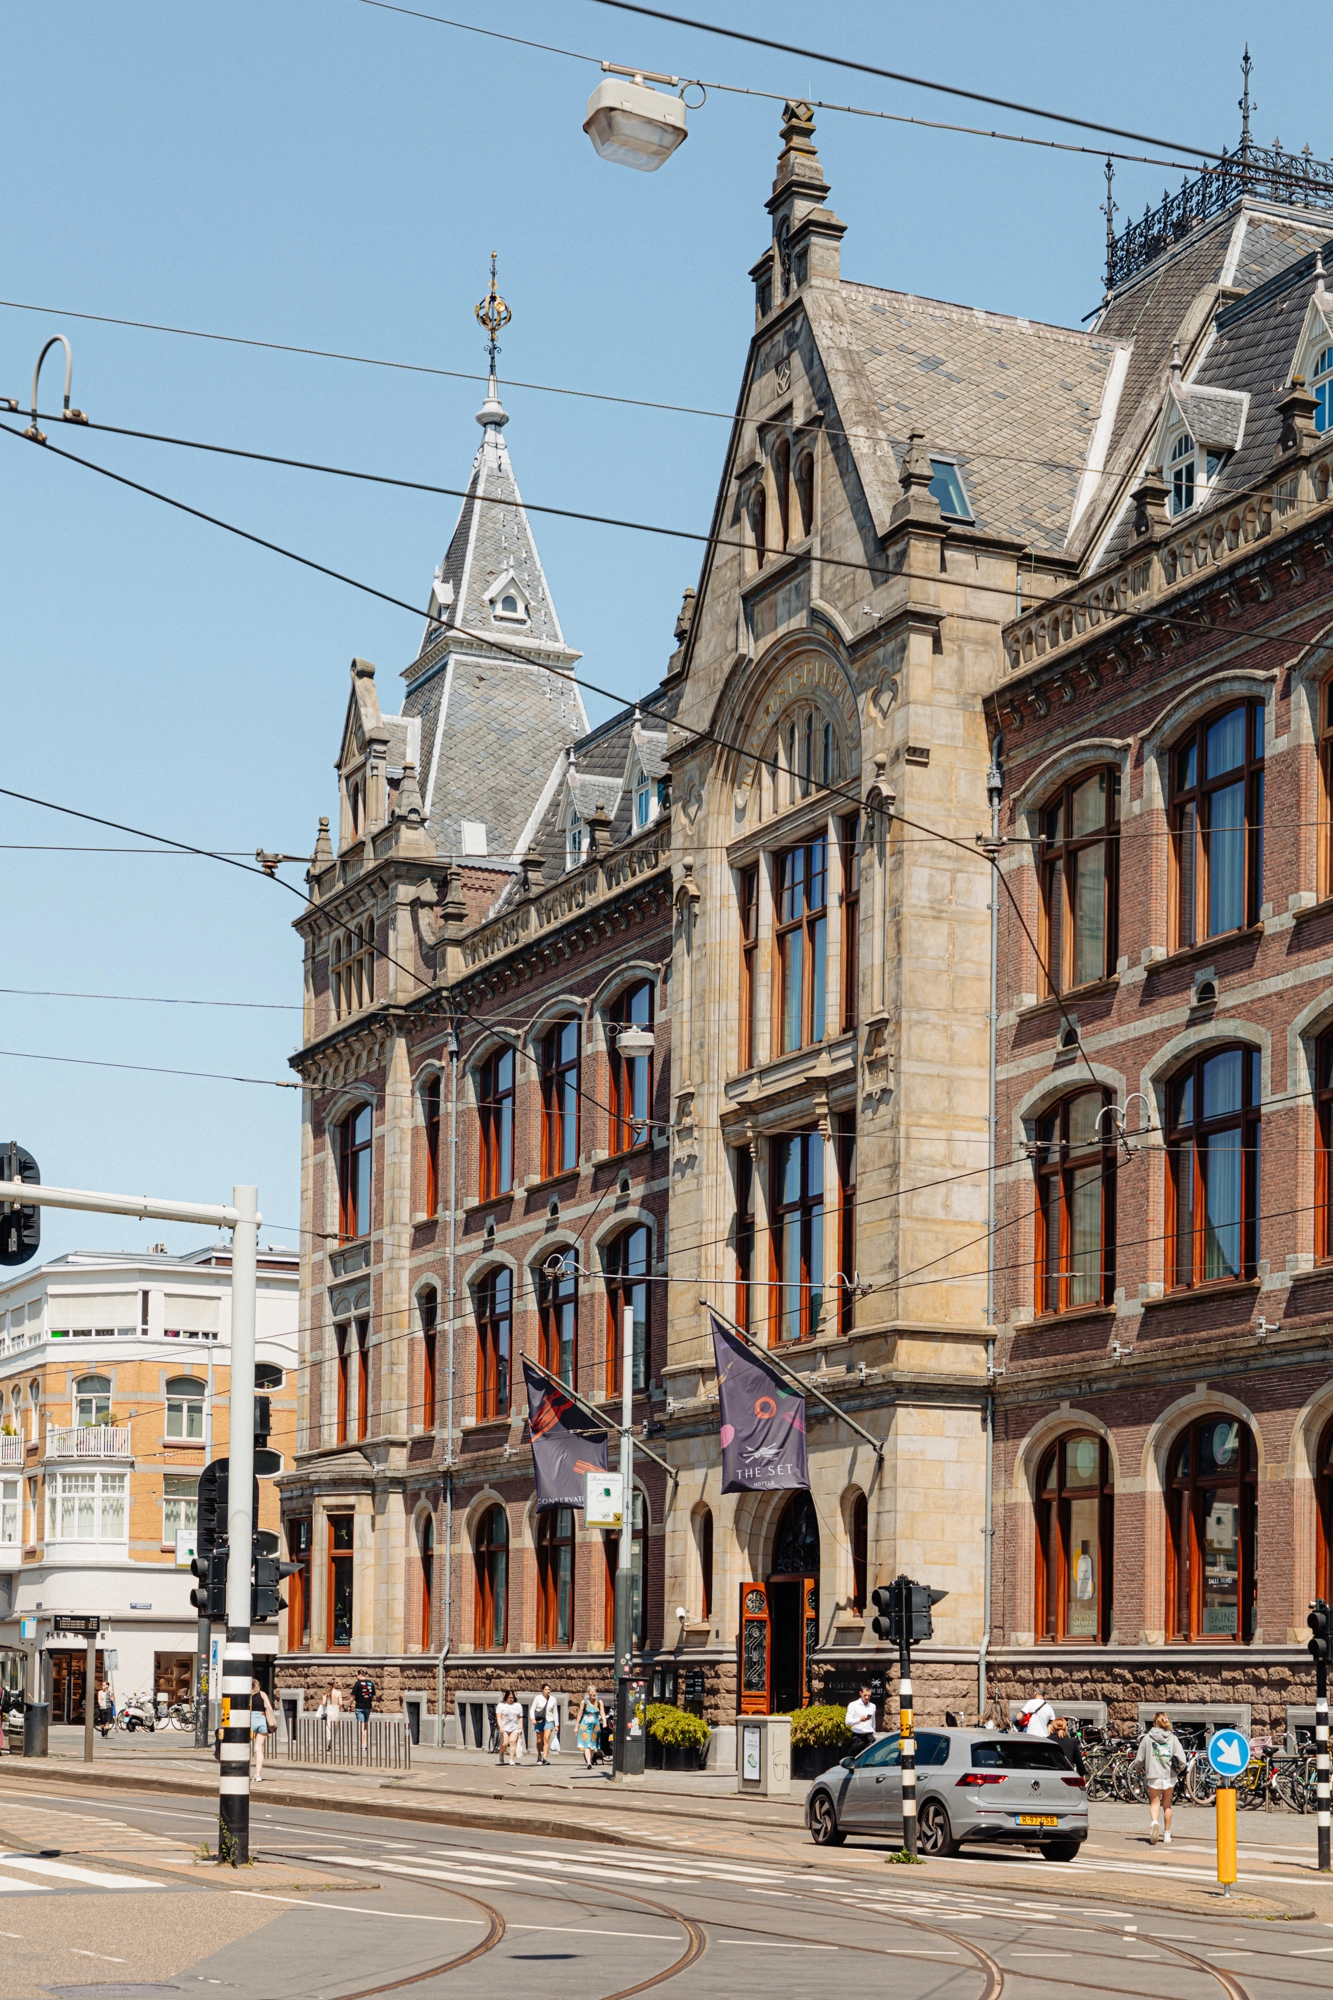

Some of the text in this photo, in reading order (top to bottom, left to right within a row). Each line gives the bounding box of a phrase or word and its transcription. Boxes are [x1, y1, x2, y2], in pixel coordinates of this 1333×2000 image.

[735, 1463, 793, 1480] THE SET
[753, 1479, 775, 1487] HOTELS
[1073, 1614, 1097, 1626] SKINS
[1209, 1611, 1236, 1623] SKINS
[1208, 1624, 1236, 1632] COSMETICS
